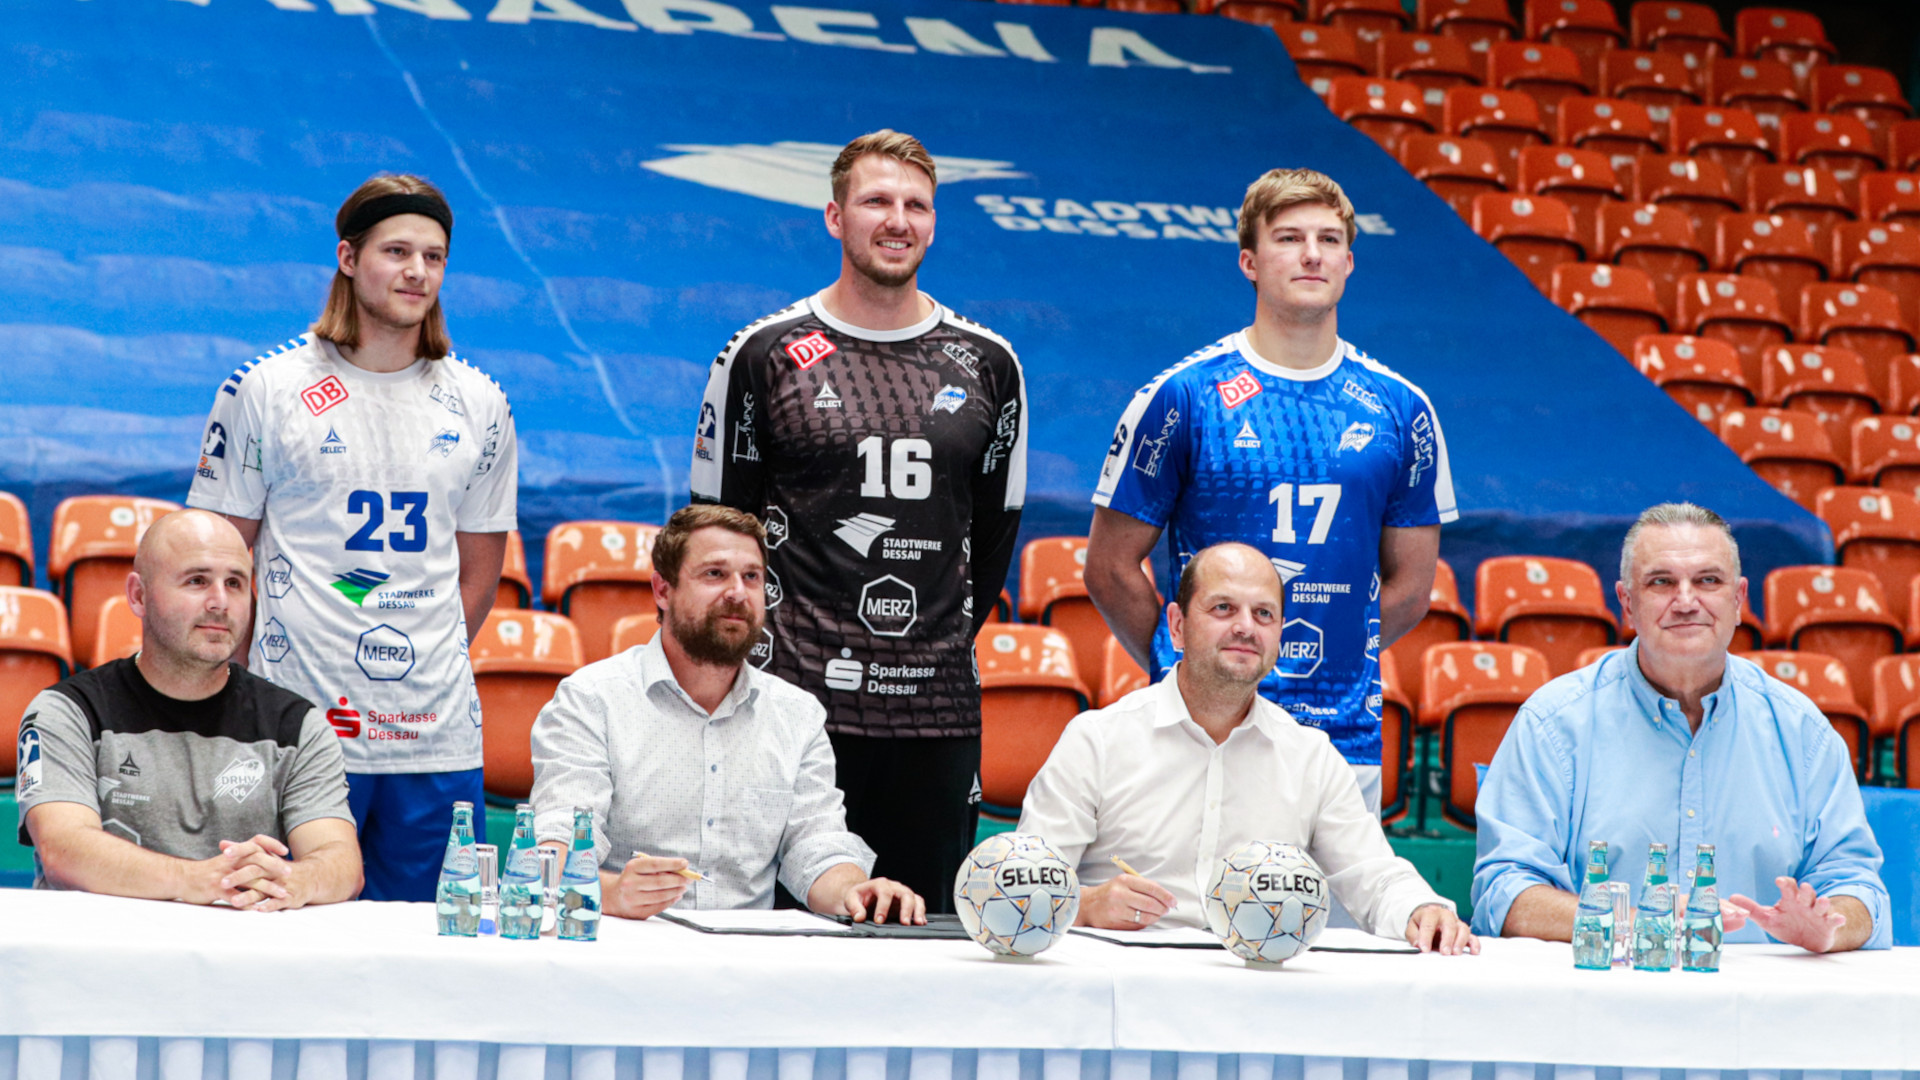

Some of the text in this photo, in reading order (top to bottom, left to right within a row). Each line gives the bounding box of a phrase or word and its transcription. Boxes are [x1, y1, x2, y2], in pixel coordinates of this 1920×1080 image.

[796, 337, 828, 363] DB
[1222, 374, 1255, 404] DB
[307, 382, 341, 411] DB
[813, 400, 843, 408] SELECT
[320, 446, 346, 454] SELECT
[1233, 439, 1261, 448] SELECT
[857, 436, 932, 499] 16
[1269, 482, 1342, 544] 17
[345, 490, 428, 552] 23
[882, 538, 942, 551] STADTWERKE
[882, 549, 922, 560] DESSAU
[378, 588, 435, 600] STADTWERKE
[1292, 583, 1350, 593] STADTWERKE
[378, 600, 416, 609] DESSAU
[1292, 593, 1330, 603] DESSAU
[866, 598, 911, 617] MERZ
[363, 645, 408, 662] MERZ
[869, 663, 935, 678] Sparkasse
[867, 683, 917, 695] Dessau
[367, 711, 437, 724] Sparkasse
[367, 728, 419, 740] Dessau
[221, 775, 256, 786] DRHV
[233, 787, 246, 797] 06
[1002, 866, 1067, 888] SELECT
[1257, 873, 1320, 896] SELECT
